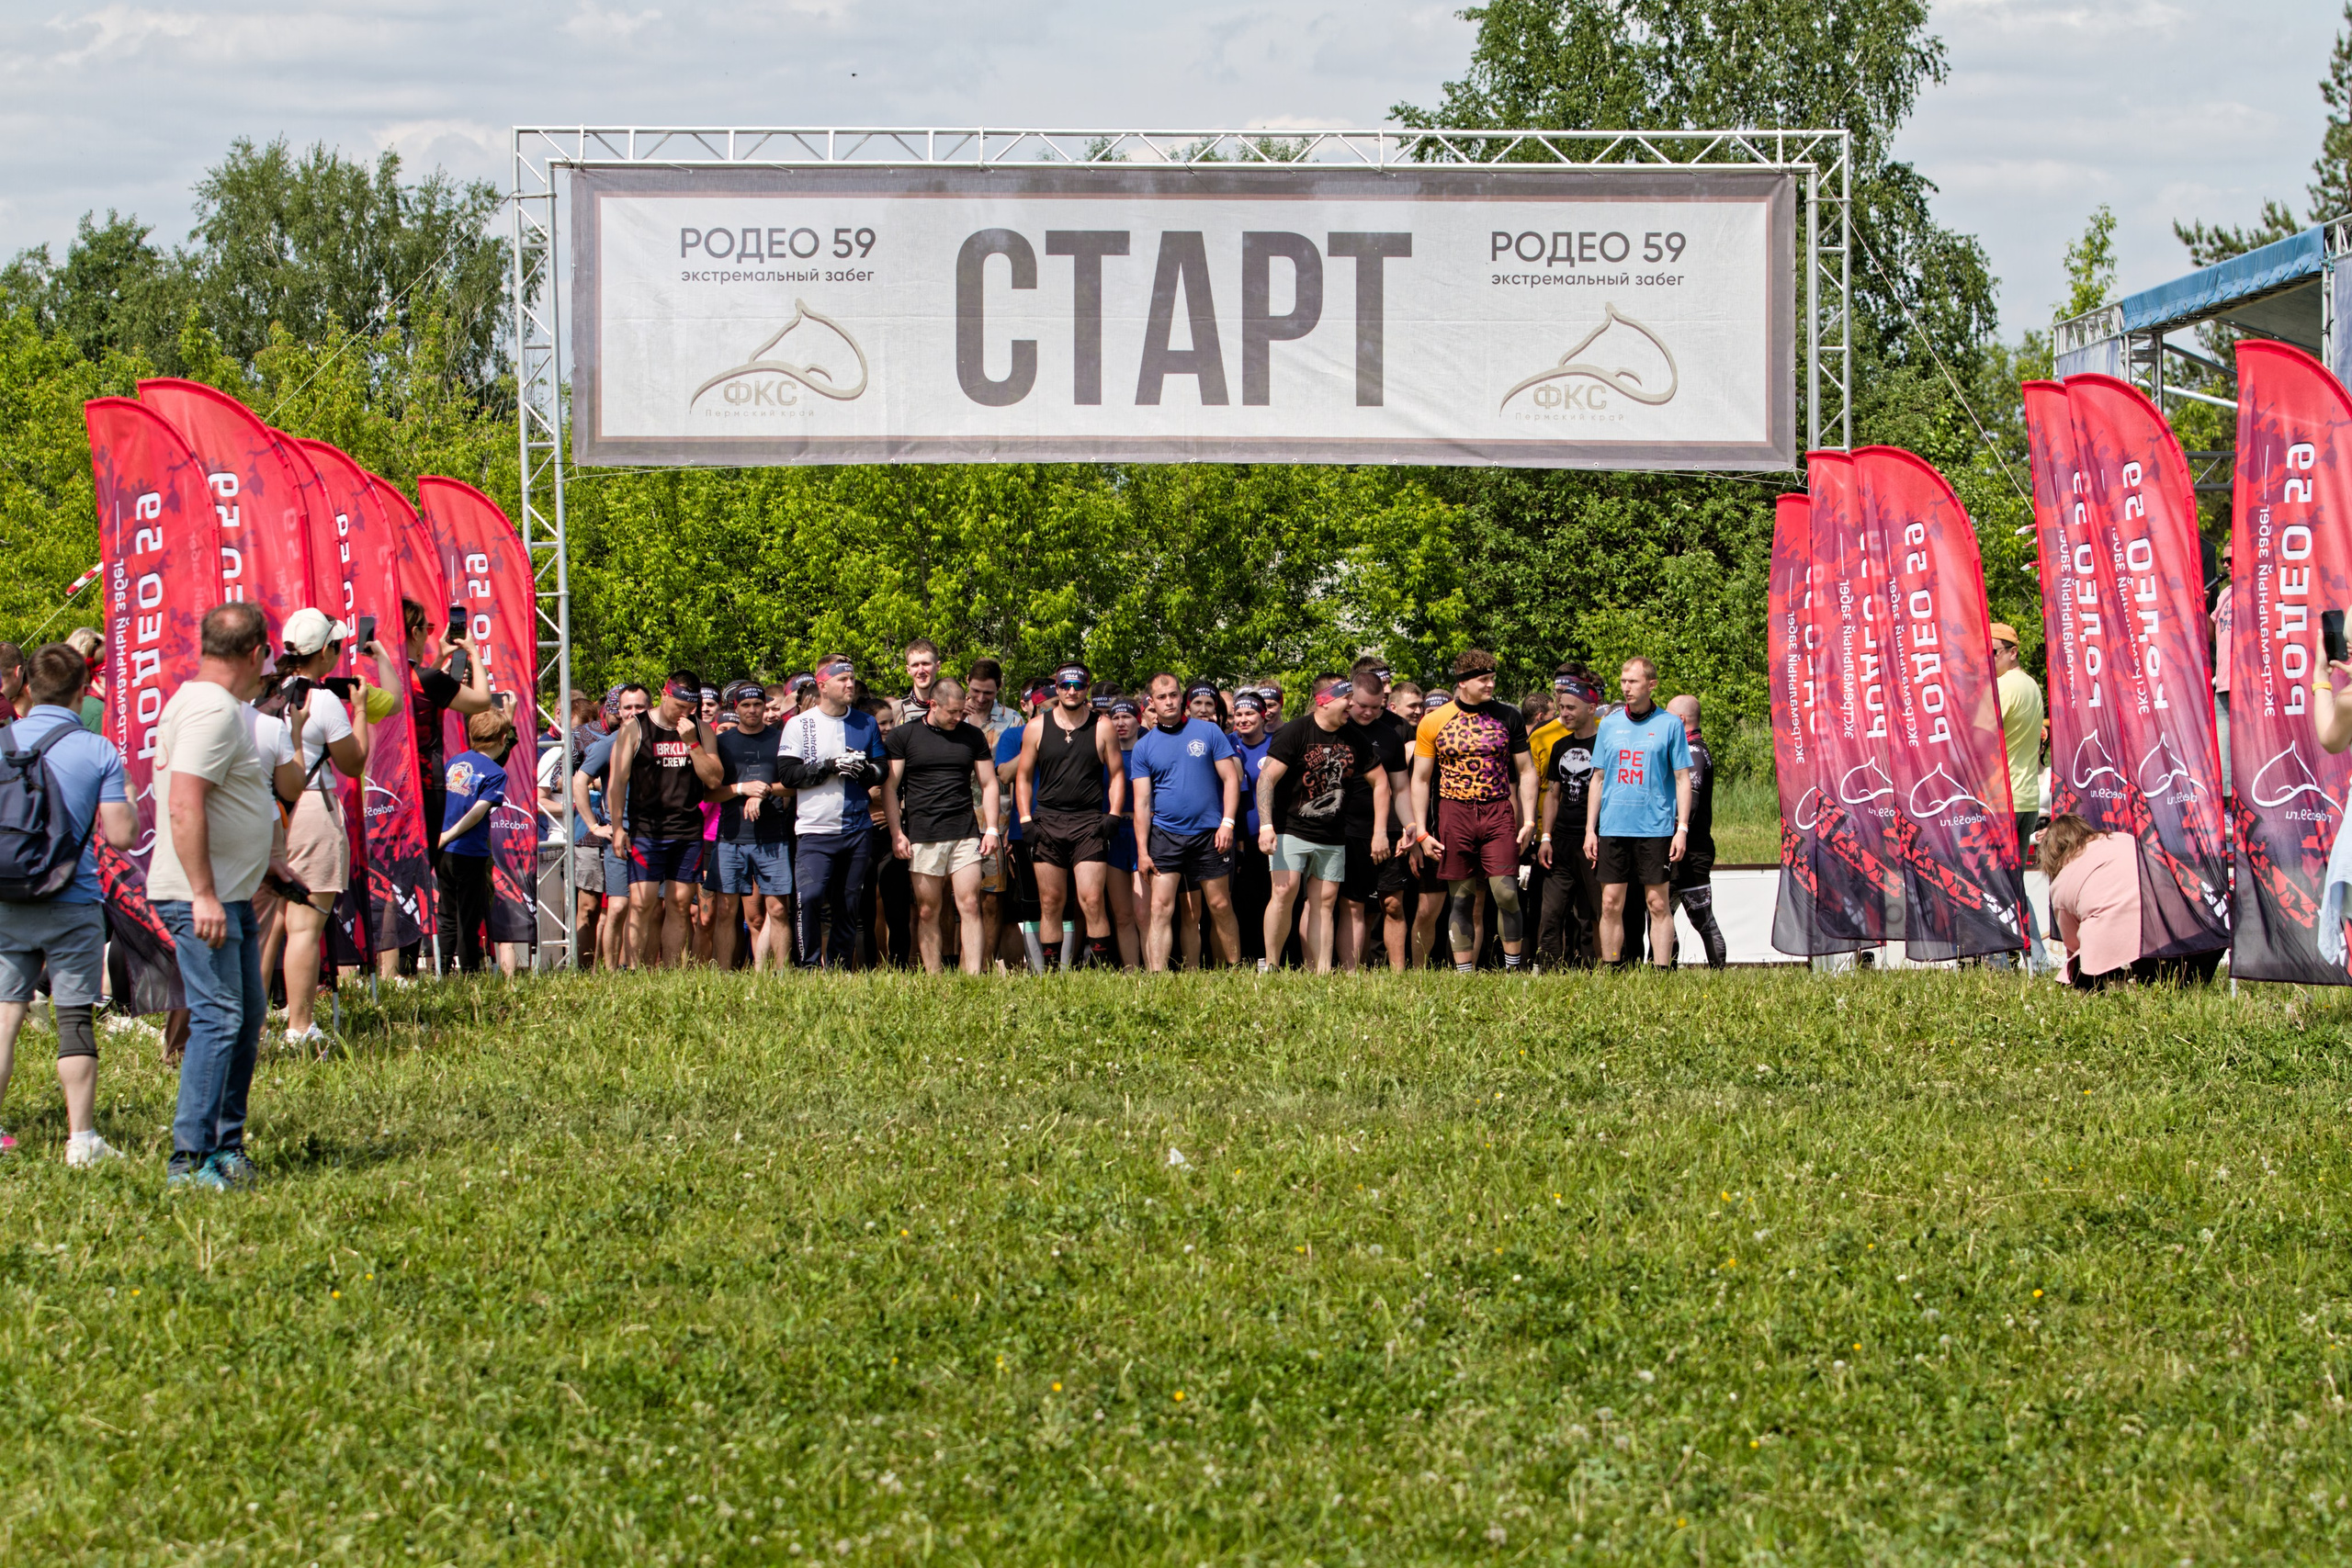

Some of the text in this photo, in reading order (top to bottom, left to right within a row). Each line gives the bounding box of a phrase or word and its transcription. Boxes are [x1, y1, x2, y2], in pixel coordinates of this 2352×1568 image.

[681, 227, 876, 264] РОДЕО 59
[1490, 231, 1686, 267] РОДЕО 59
[681, 268, 874, 284] экстремальный забег
[1491, 272, 1685, 288] экстремальный забег
[956, 228, 1412, 407] СТАРТ
[723, 380, 797, 407] ФКС
[1533, 384, 1608, 411] ФКС
[705, 409, 816, 419] Пермский край
[1515, 412, 1625, 422] Пермский край
[662, 757, 686, 767] CREW
[1619, 749, 1644, 767] PE
[1618, 768, 1644, 784] RM
